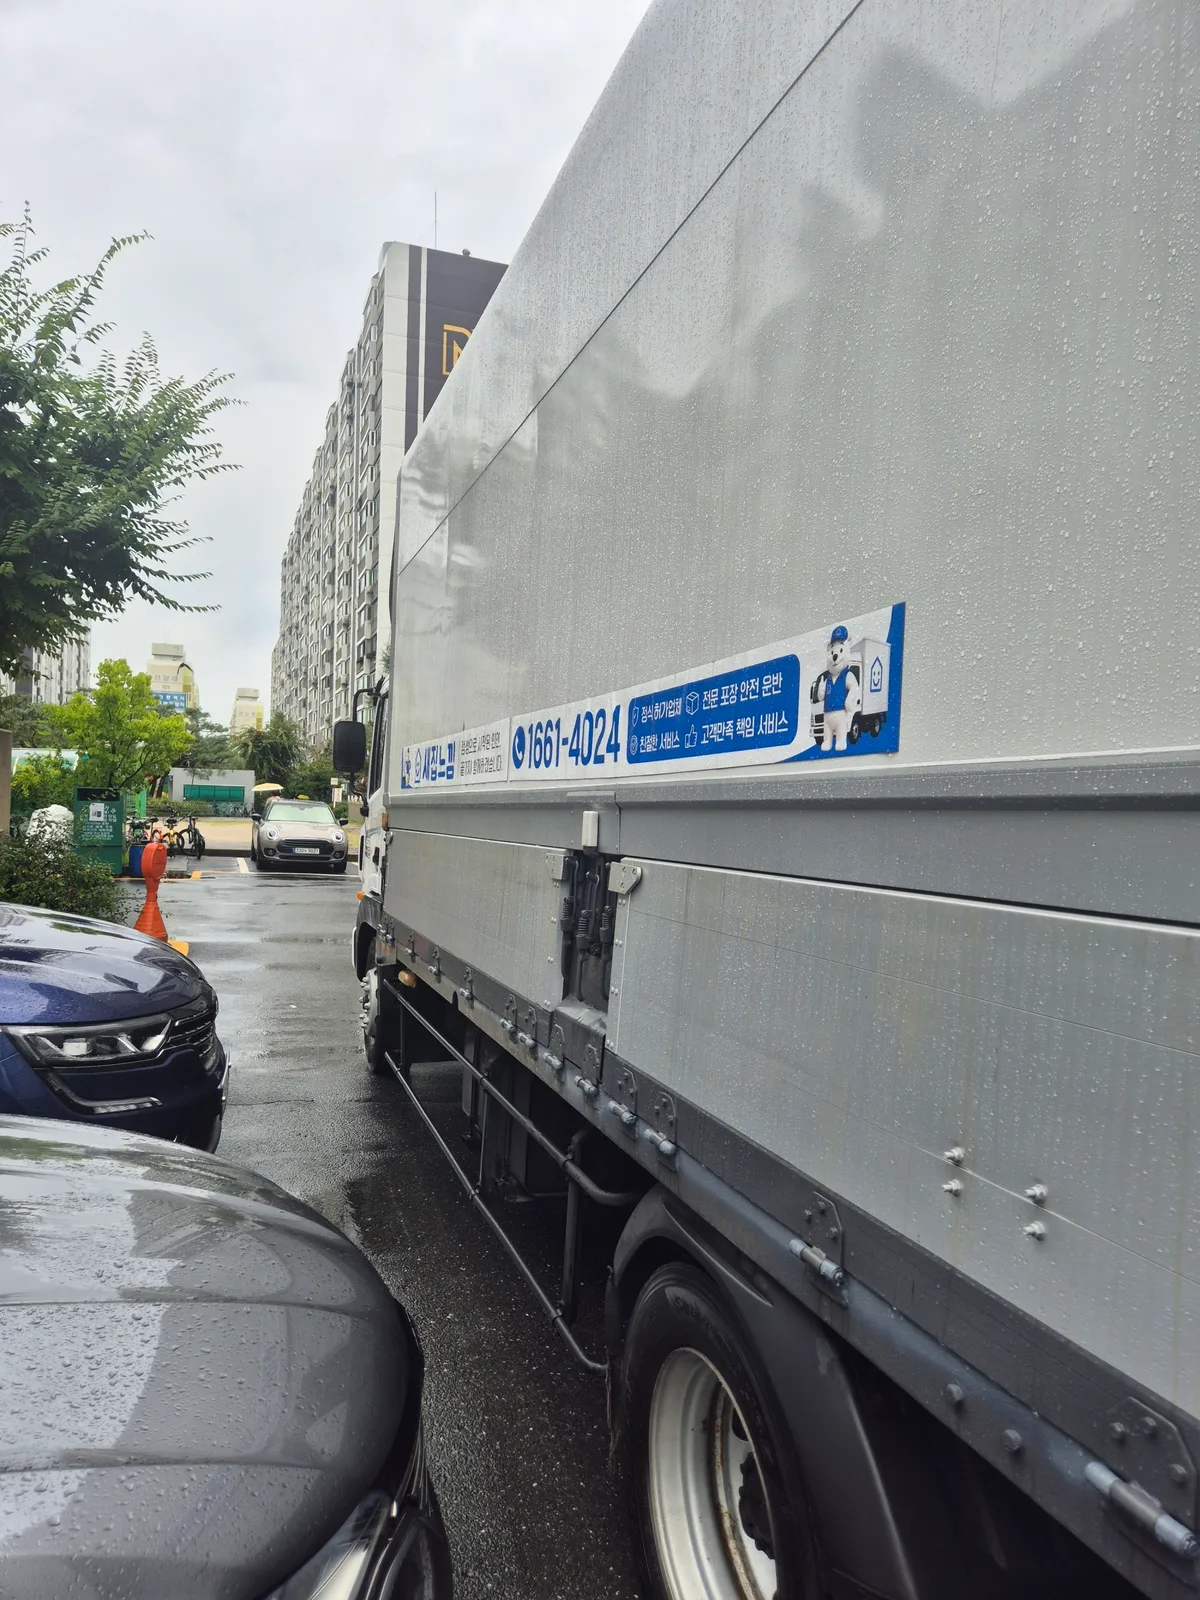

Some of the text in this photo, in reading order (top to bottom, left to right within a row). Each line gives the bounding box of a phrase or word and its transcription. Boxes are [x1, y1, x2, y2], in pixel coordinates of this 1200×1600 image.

[702, 672, 783, 710] 전문 포장 안전 운반
[528, 705, 621, 769] 1661-4024
[639, 731, 680, 753] 친절한 서비스
[701, 711, 788, 745] 고객만족 책임 서비스
[422, 741, 455, 781] 새집느낌
